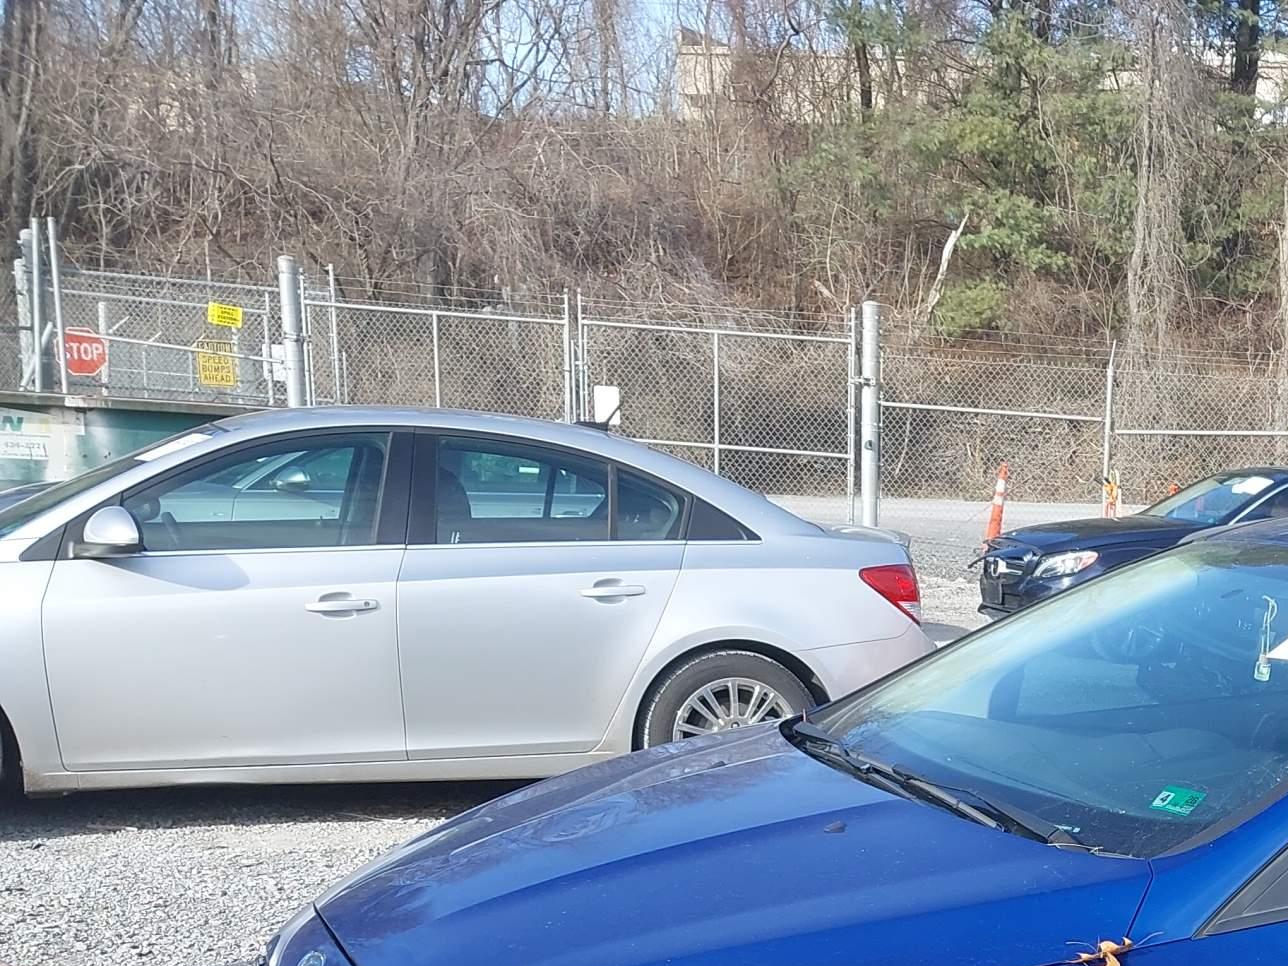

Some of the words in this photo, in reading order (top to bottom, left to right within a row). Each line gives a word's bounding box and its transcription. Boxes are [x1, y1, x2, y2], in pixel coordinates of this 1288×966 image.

[203, 354, 228, 365] SPEED
[202, 364, 231, 374] BUMPS
[203, 374, 231, 384] AHEAD
